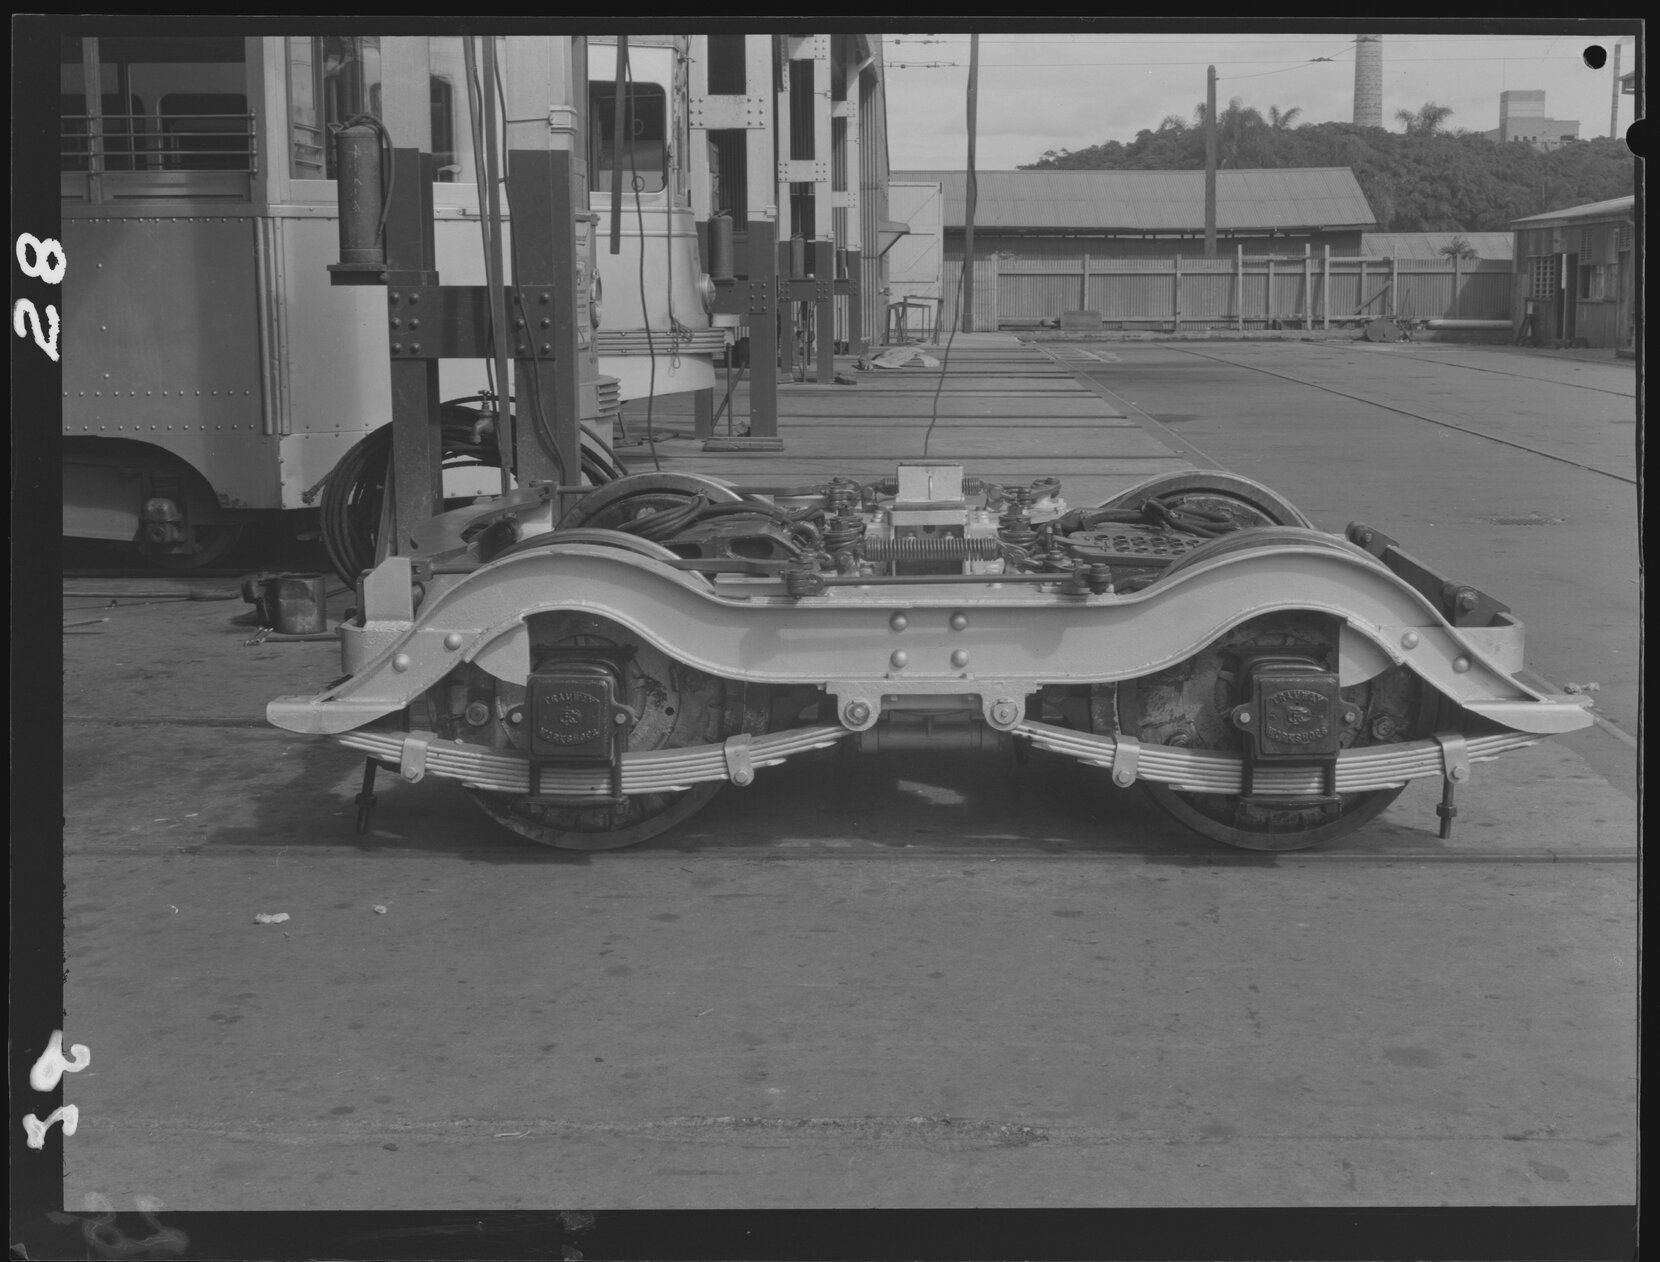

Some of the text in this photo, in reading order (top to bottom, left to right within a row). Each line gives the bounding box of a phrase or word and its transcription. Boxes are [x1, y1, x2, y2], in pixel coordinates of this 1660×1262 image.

[14, 232, 67, 362] 28
[544, 691, 600, 705] TRAMWAY
[1271, 690, 1329, 704] TRAMWAY
[1266, 726, 1329, 745] WORKSHOPS
